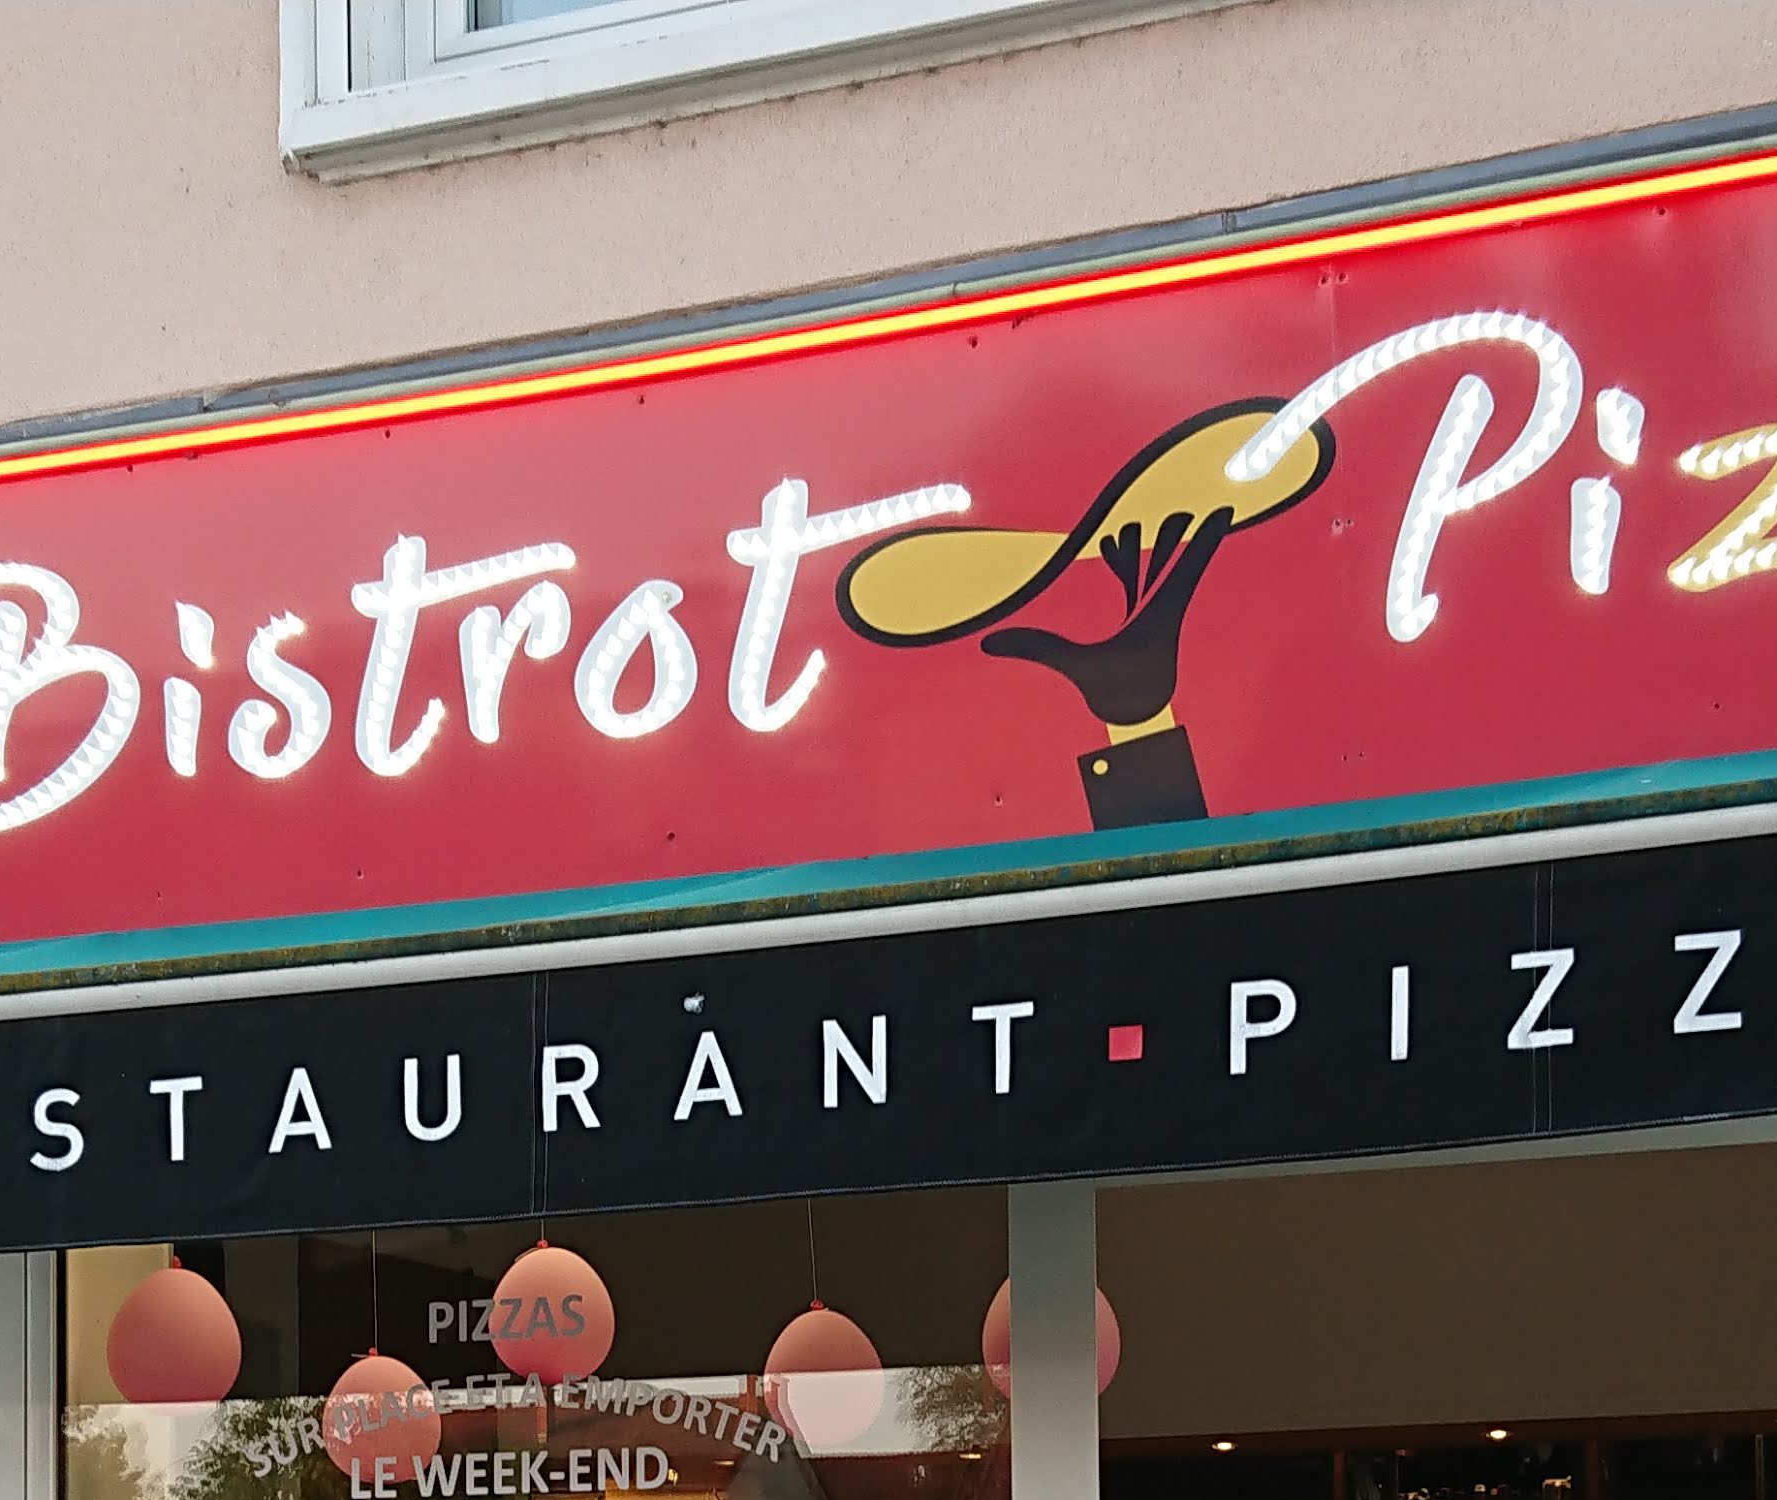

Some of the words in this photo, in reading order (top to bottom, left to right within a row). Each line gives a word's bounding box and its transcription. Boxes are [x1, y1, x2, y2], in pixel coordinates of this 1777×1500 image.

[427, 1293, 586, 1344] PIZZAS
[245, 1416, 326, 1479] SUR
[332, 1379, 451, 1439] PLACE
[465, 1372, 512, 1411] ET
[520, 1372, 547, 1409] A
[560, 1373, 788, 1464] EMPORTER
[349, 1455, 398, 1500] LE
[411, 1445, 670, 1499] WEEK-END
